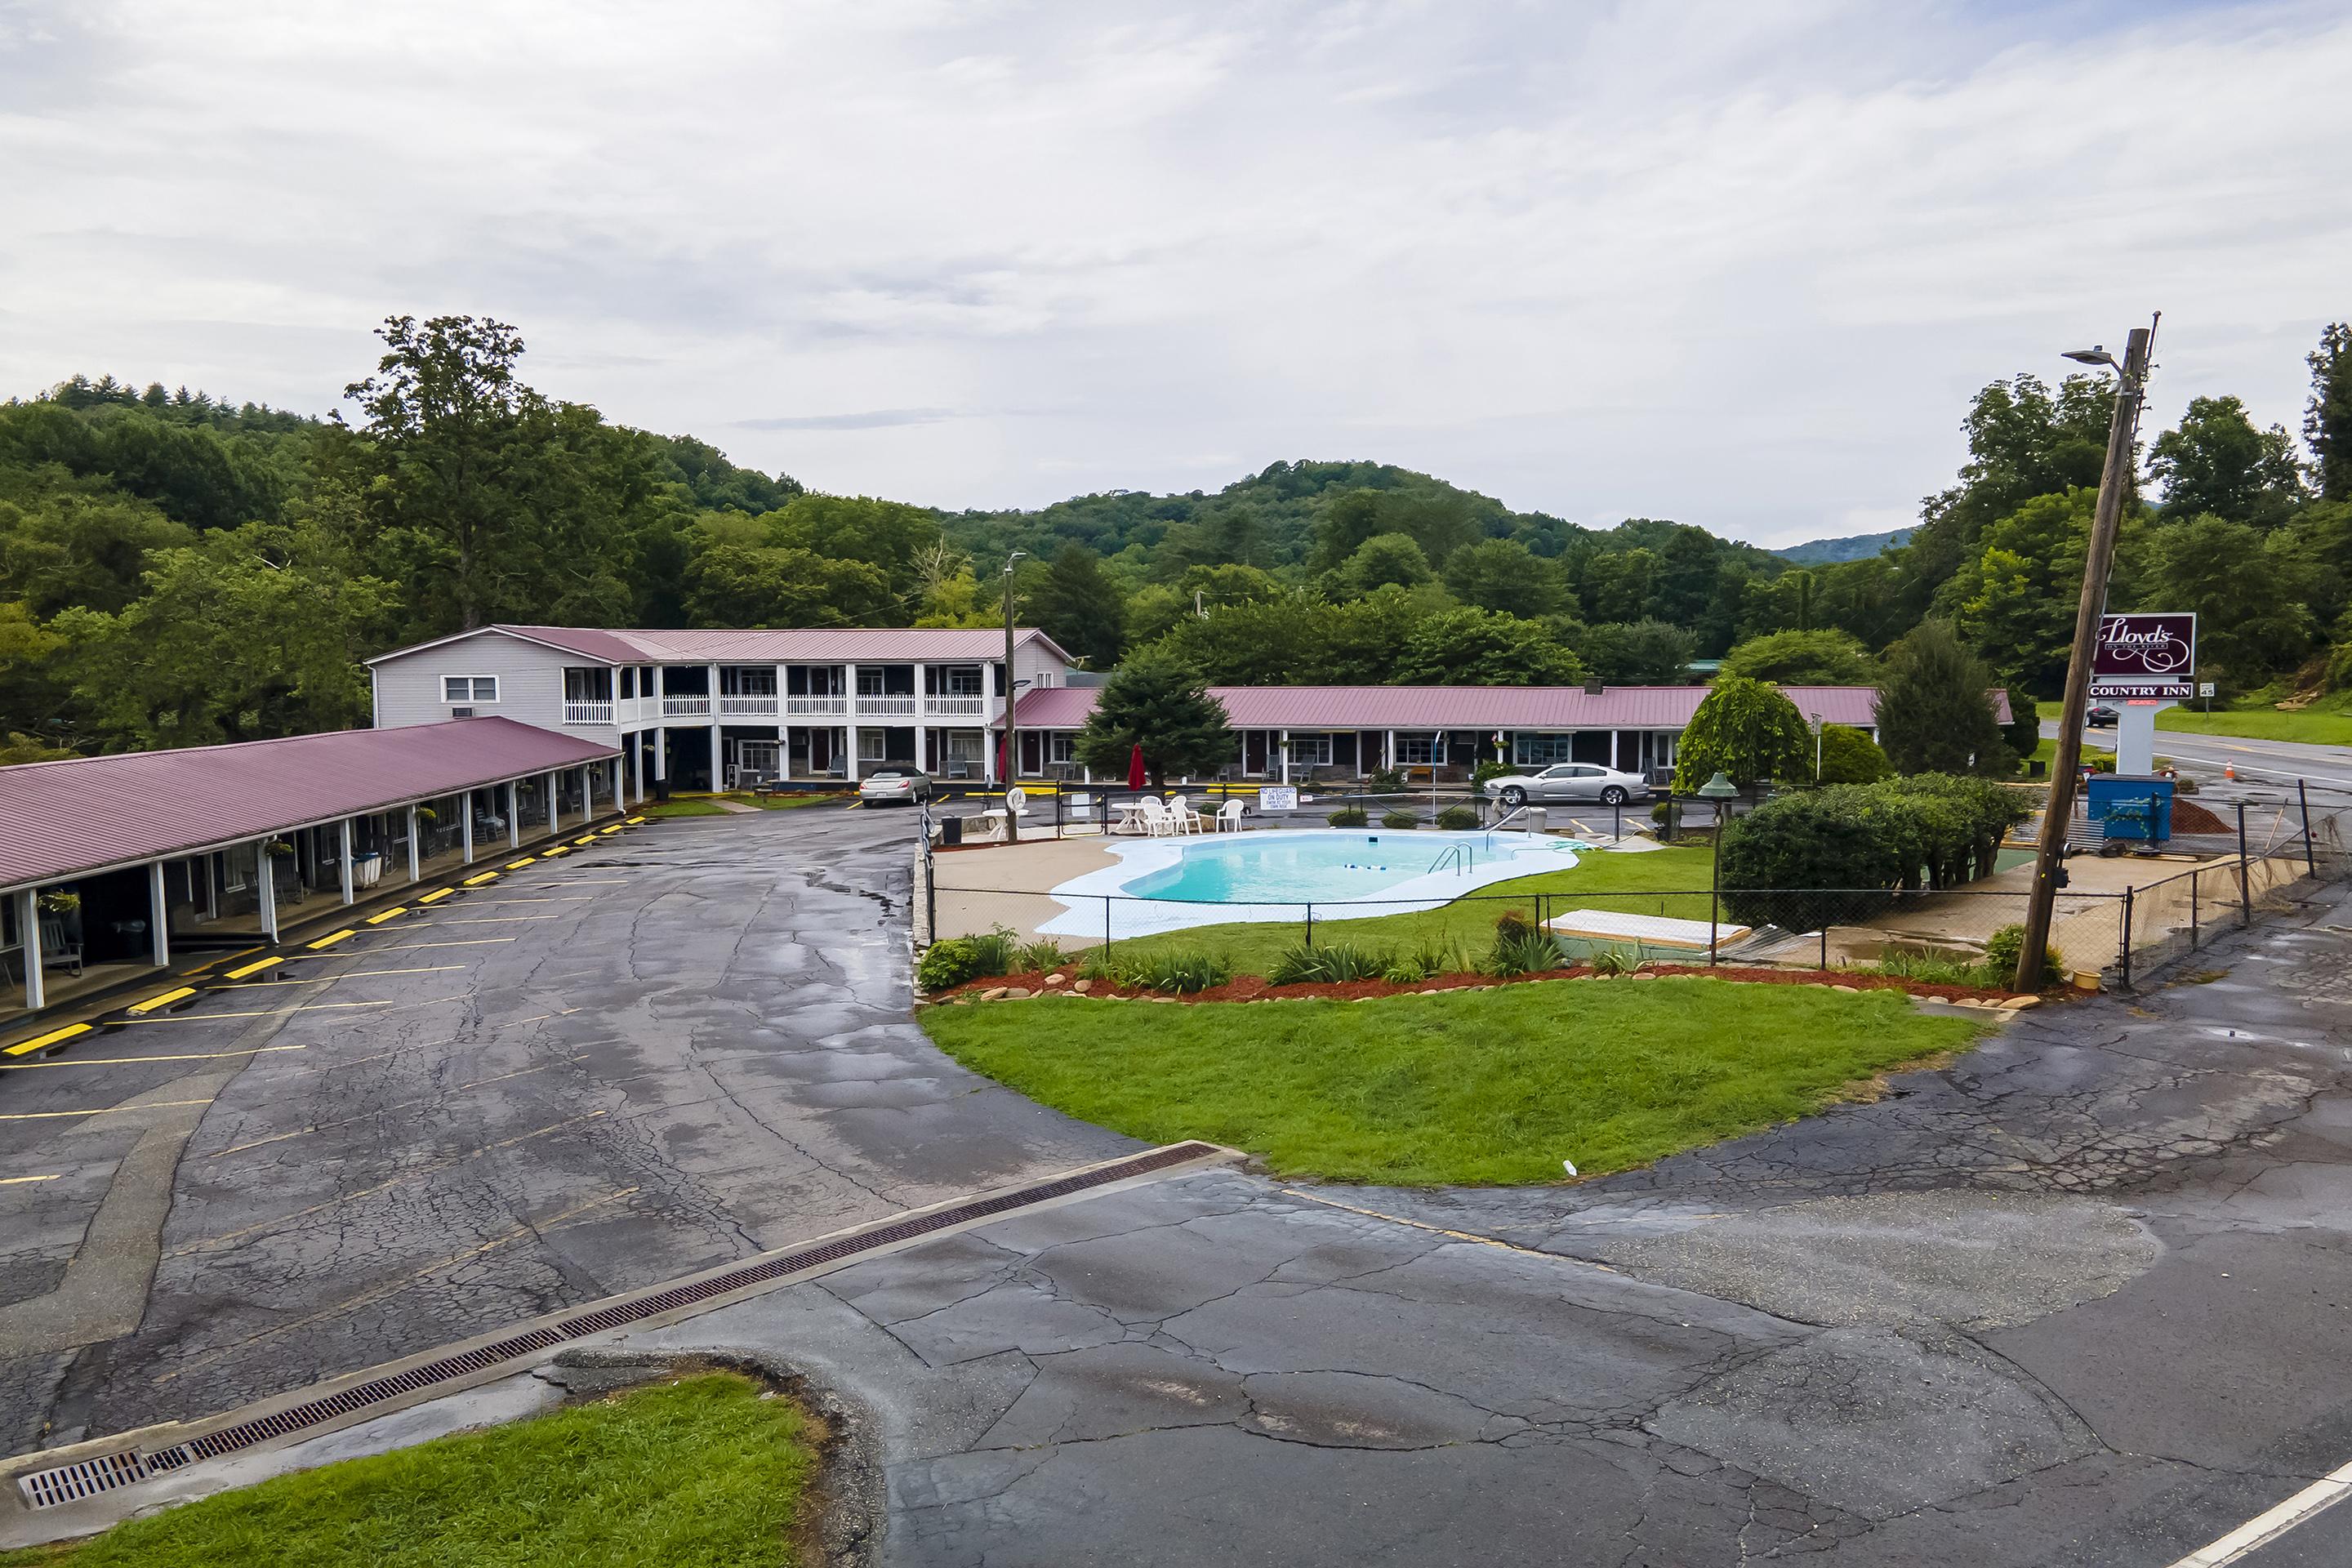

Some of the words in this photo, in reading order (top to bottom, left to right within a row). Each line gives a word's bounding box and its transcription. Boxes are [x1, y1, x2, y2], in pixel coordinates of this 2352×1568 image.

[2096, 617, 2173, 644] Lloyd's
[2090, 687, 2158, 696] COUNTRY
[2163, 687, 2190, 696] INN
